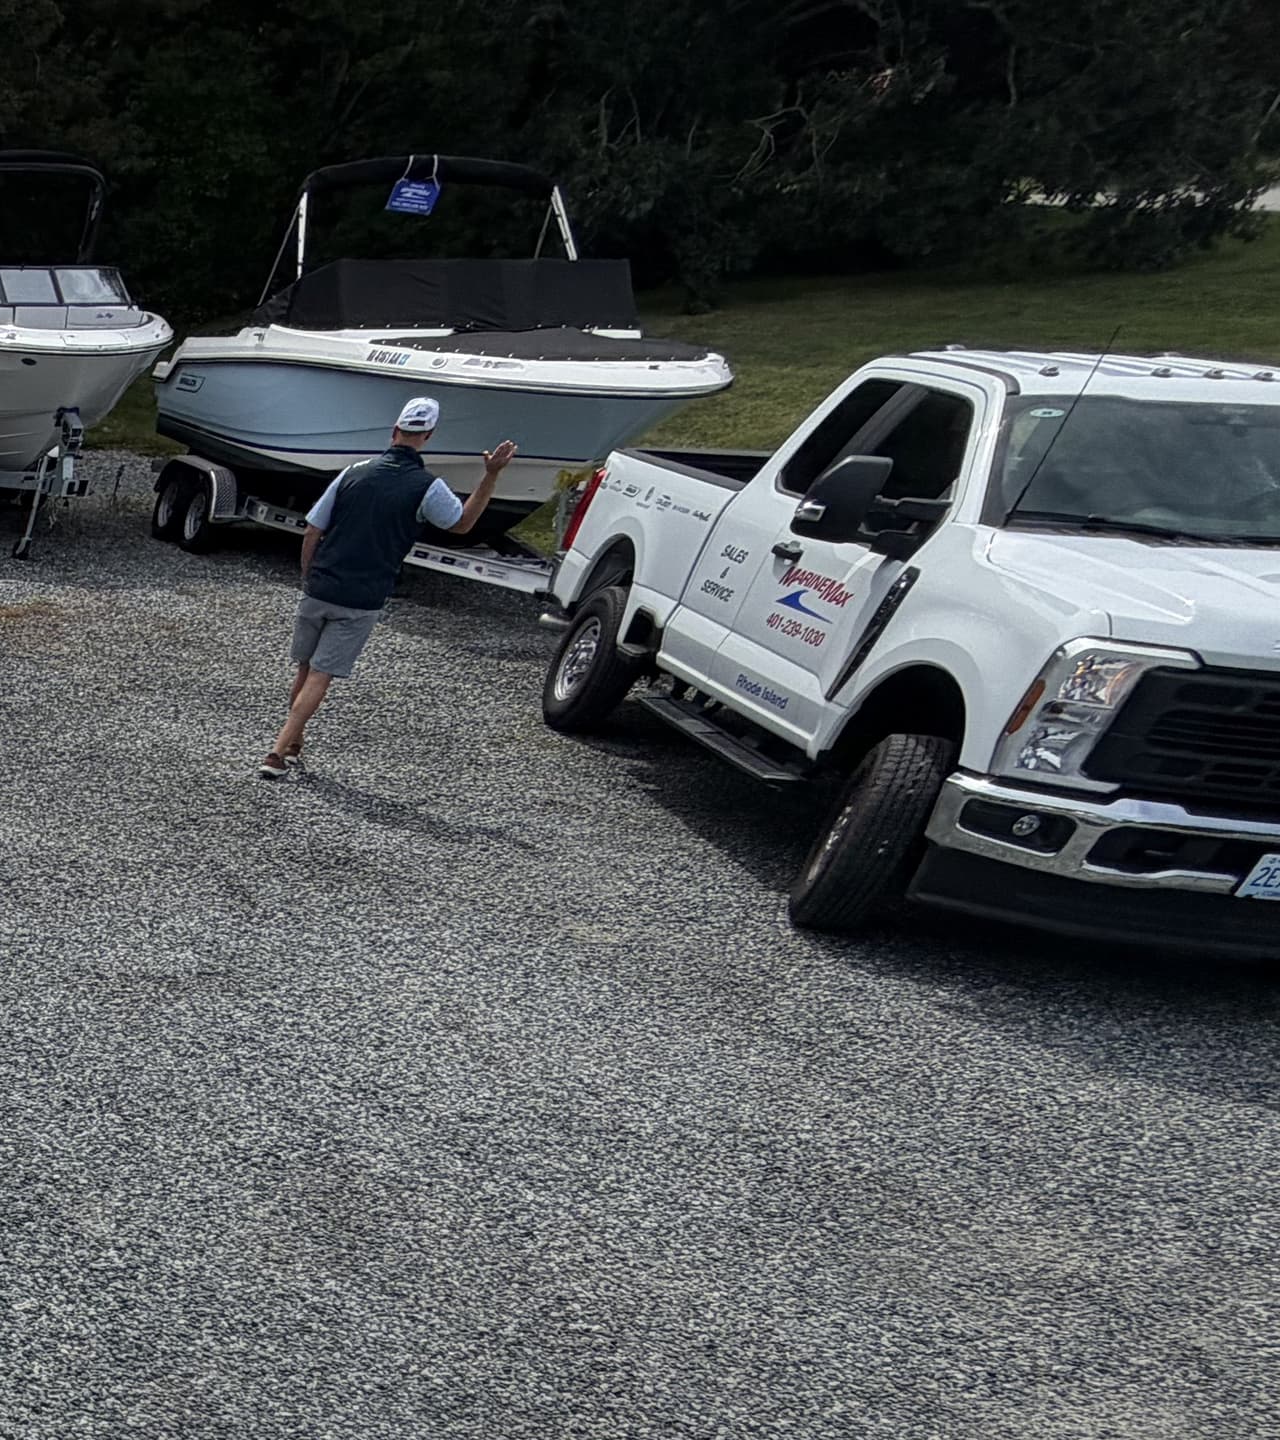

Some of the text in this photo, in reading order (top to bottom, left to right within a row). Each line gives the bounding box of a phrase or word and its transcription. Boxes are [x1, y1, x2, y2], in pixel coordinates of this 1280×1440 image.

[721, 544, 749, 564] SALES
[700, 579, 735, 602] SERVICE
[766, 612, 825, 647] 401-239-1030
[736, 674, 790, 709] Rhode Island
